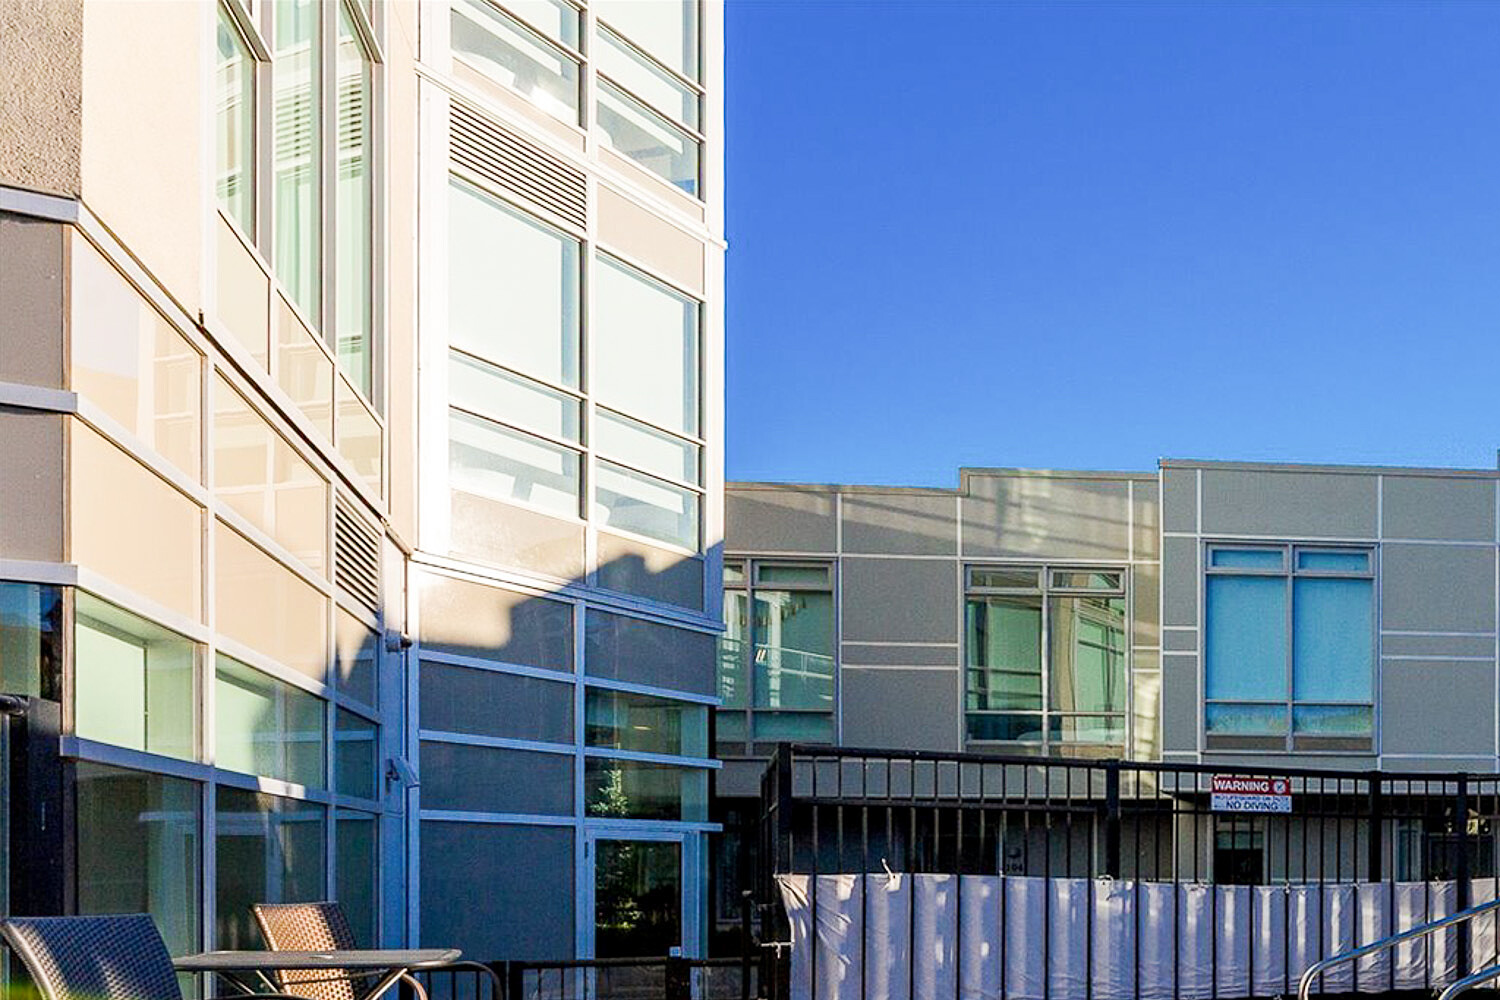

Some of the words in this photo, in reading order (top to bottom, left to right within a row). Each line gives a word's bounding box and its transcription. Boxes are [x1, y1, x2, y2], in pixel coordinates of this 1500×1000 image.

[1213, 780, 1269, 792] WARNING
[1226, 800, 1242, 809] NO
[1243, 801, 1278, 810] DIVING
